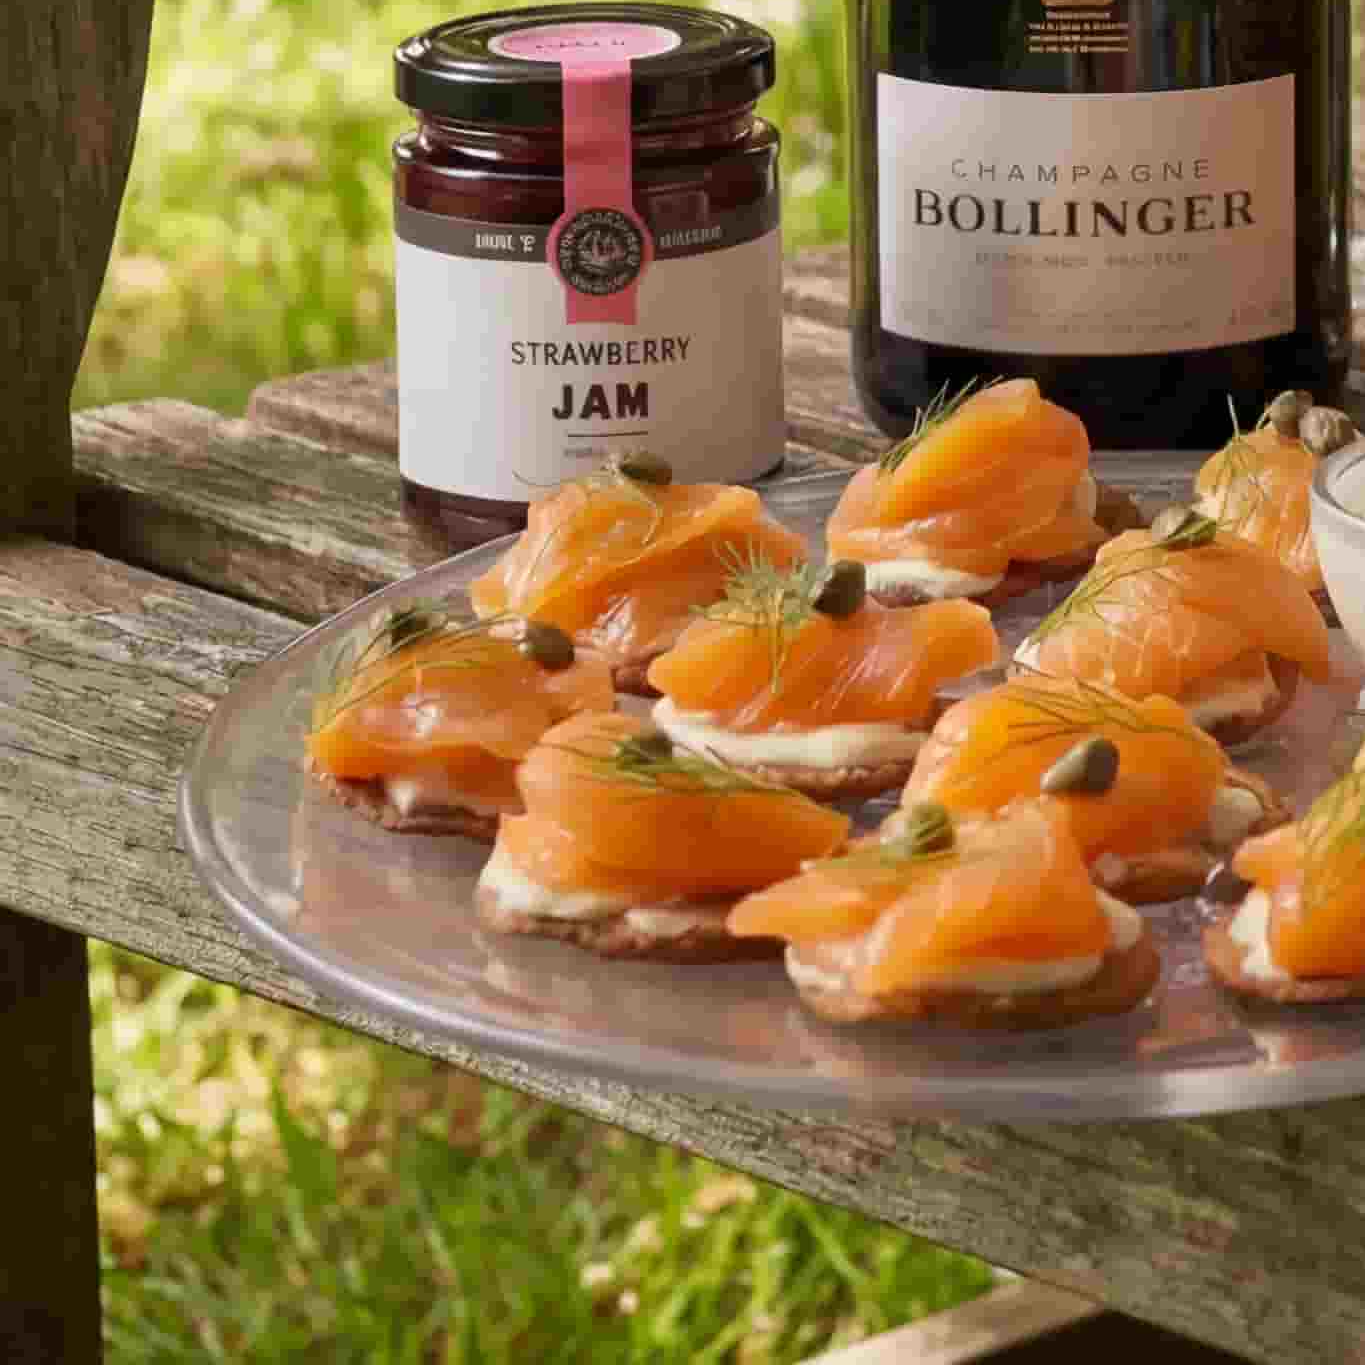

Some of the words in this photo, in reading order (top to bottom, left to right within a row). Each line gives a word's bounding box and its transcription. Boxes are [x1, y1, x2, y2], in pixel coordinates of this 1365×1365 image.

[950, 157, 1211, 185] CHAMPAGNE
[912, 187, 1257, 239] BOLLINGER
[510, 335, 691, 366] STRAWBERRY
[551, 382, 650, 421] JAM
